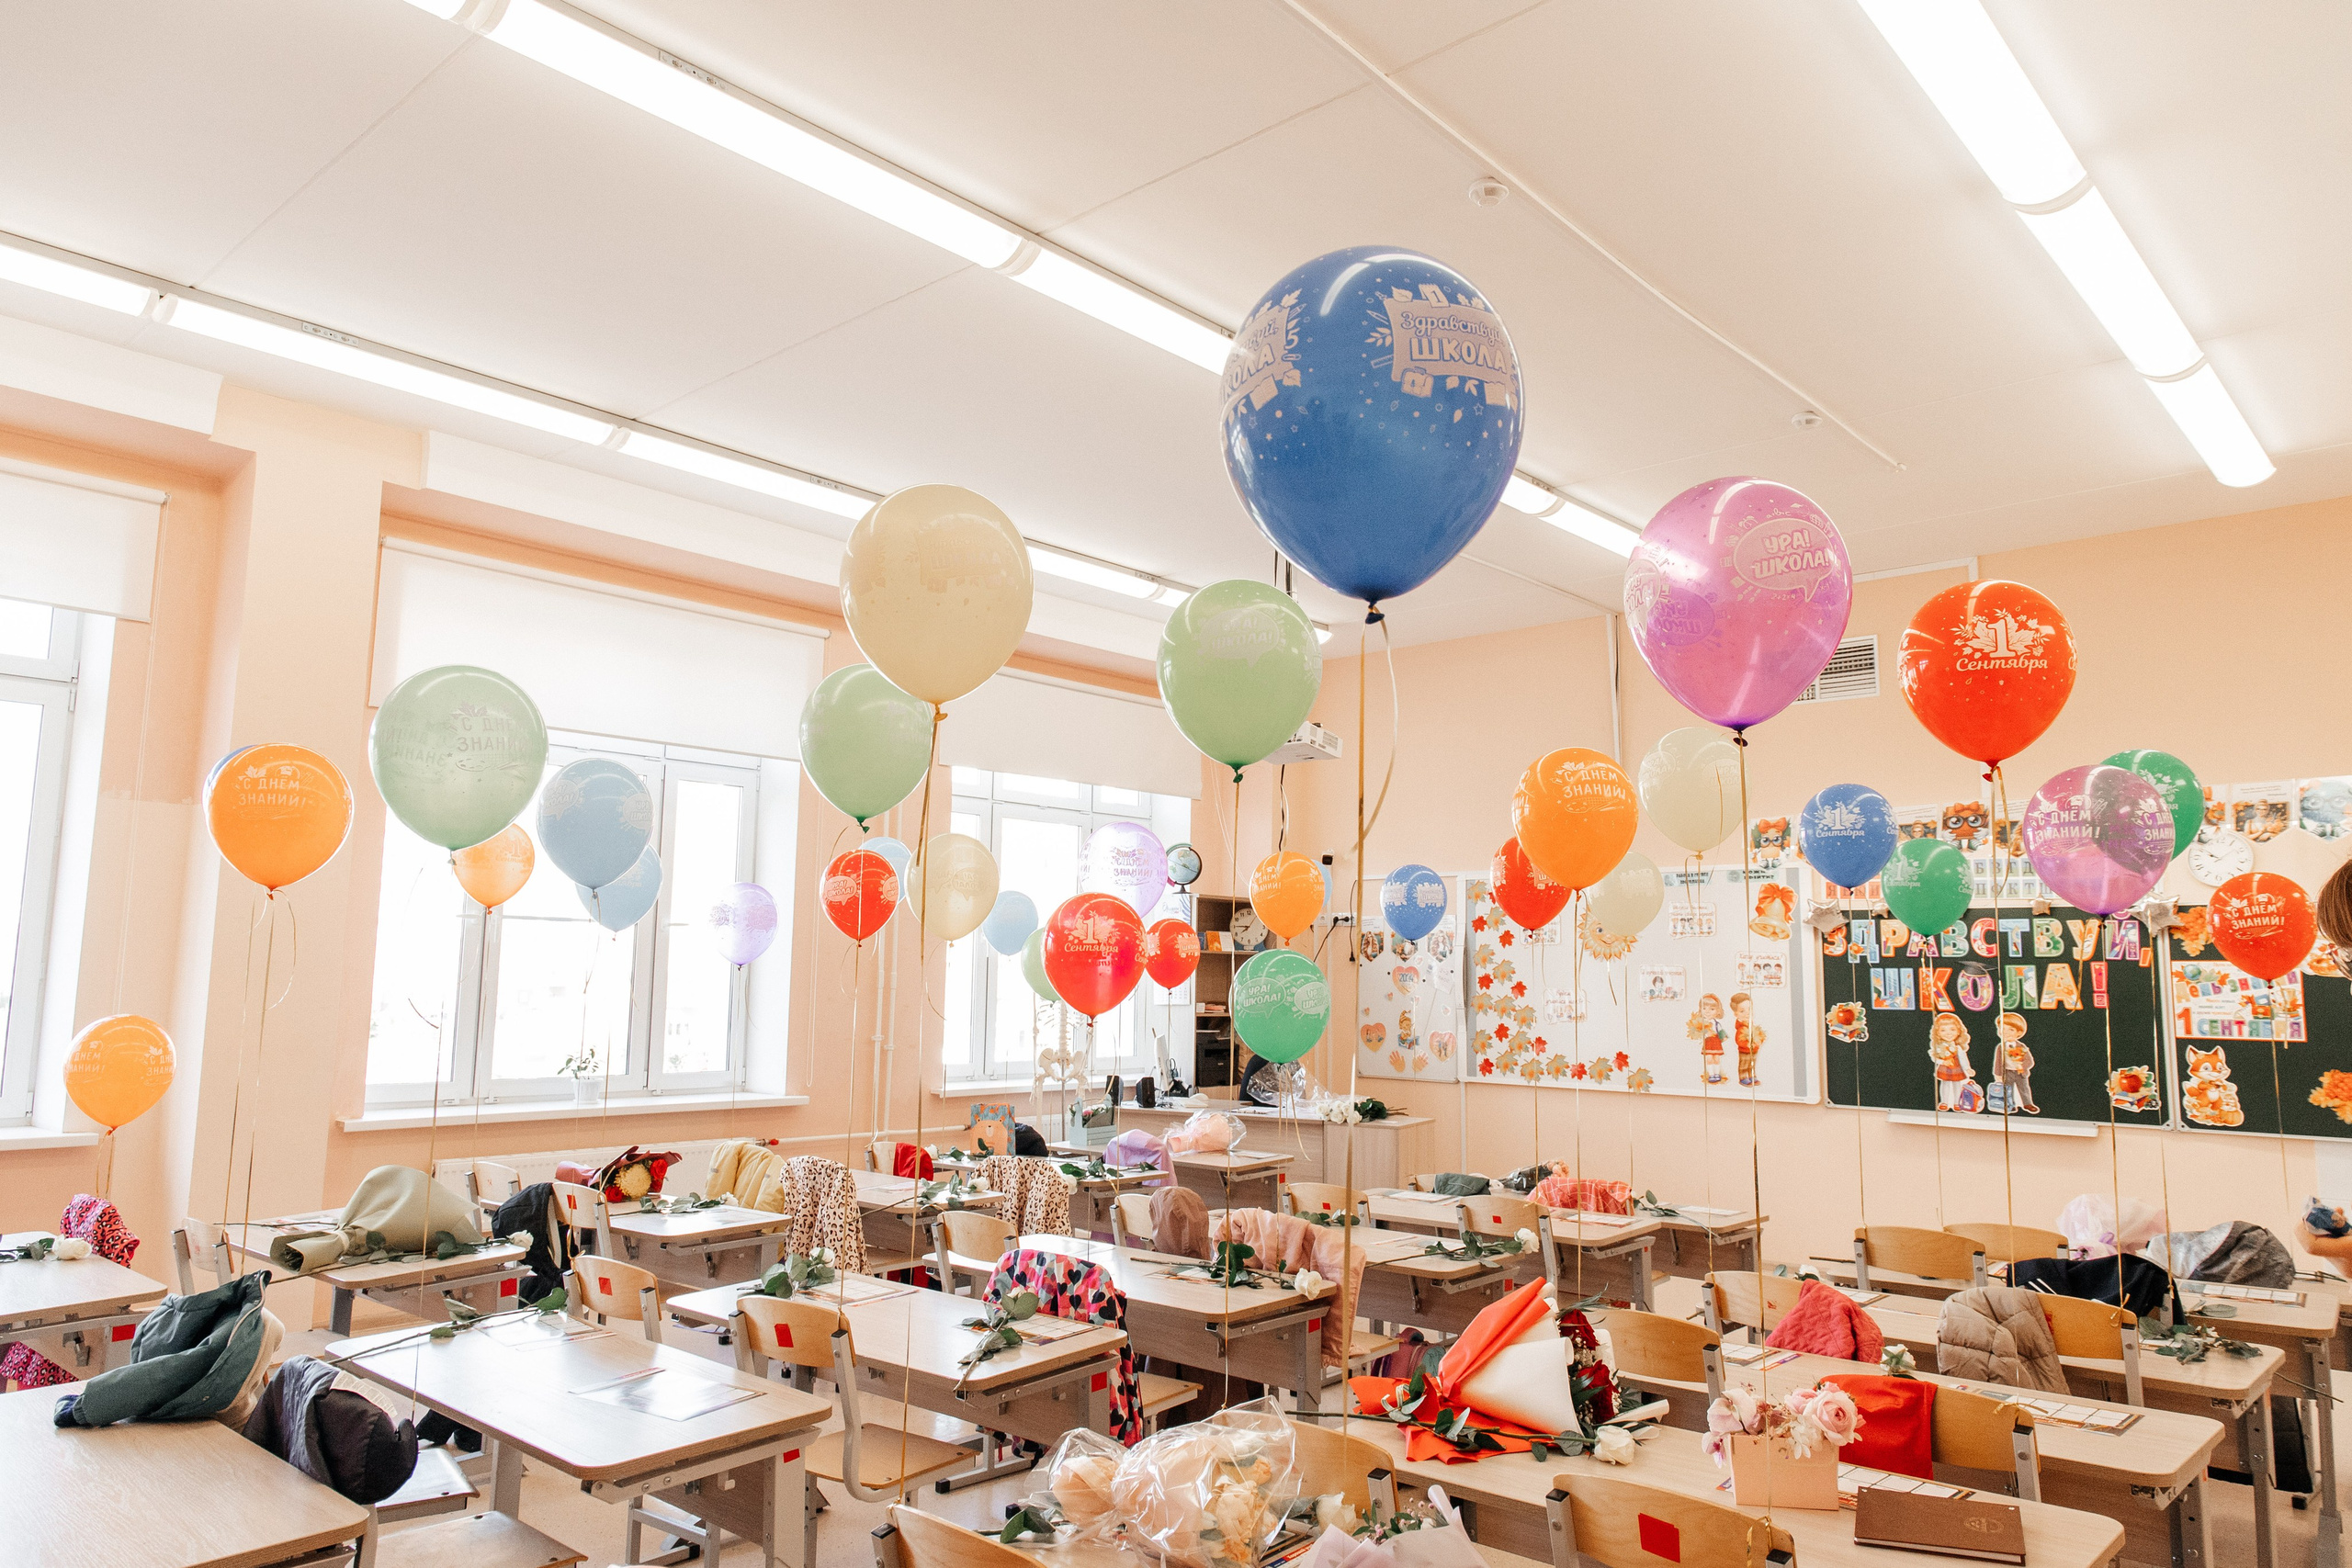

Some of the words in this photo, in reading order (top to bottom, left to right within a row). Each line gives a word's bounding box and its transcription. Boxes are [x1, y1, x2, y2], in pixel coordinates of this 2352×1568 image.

[1409, 337, 1509, 375] ШКОЛА
[1763, 529, 1812, 554] УРА!
[1752, 550, 1831, 580] ШКОЛА!
[1985, 617, 2018, 659] 1
[1955, 654, 2049, 674] Сентября
[243, 778, 251, 790] С
[1564, 771, 1575, 783] С
[1831, 807, 1847, 829] 1
[2050, 806, 2092, 826] ДНЁМ
[2143, 813, 2154, 826] С
[1815, 829, 1866, 839] Сентября
[1974, 862, 1984, 874] Б
[828, 886, 854, 898] ШКОЛА!
[2007, 882, 2018, 896] К
[2023, 882, 2035, 896] Т
[2232, 907, 2240, 918] С
[1082, 917, 1099, 944] 1
[2231, 914, 2286, 931] ЗНАНИЙ!
[1823, 909, 2153, 968] ЗДРАВСТВУЙ,
[1064, 942, 1119, 954] Сентября
[1248, 984, 1272, 997] УРА!
[1870, 961, 2110, 1012] ШКОЛА!
[1243, 993, 1283, 1008] ШКОЛА!
[2177, 1008, 2192, 1036] 1
[2197, 1019, 2302, 1039] СЕНТЯБРЯ
